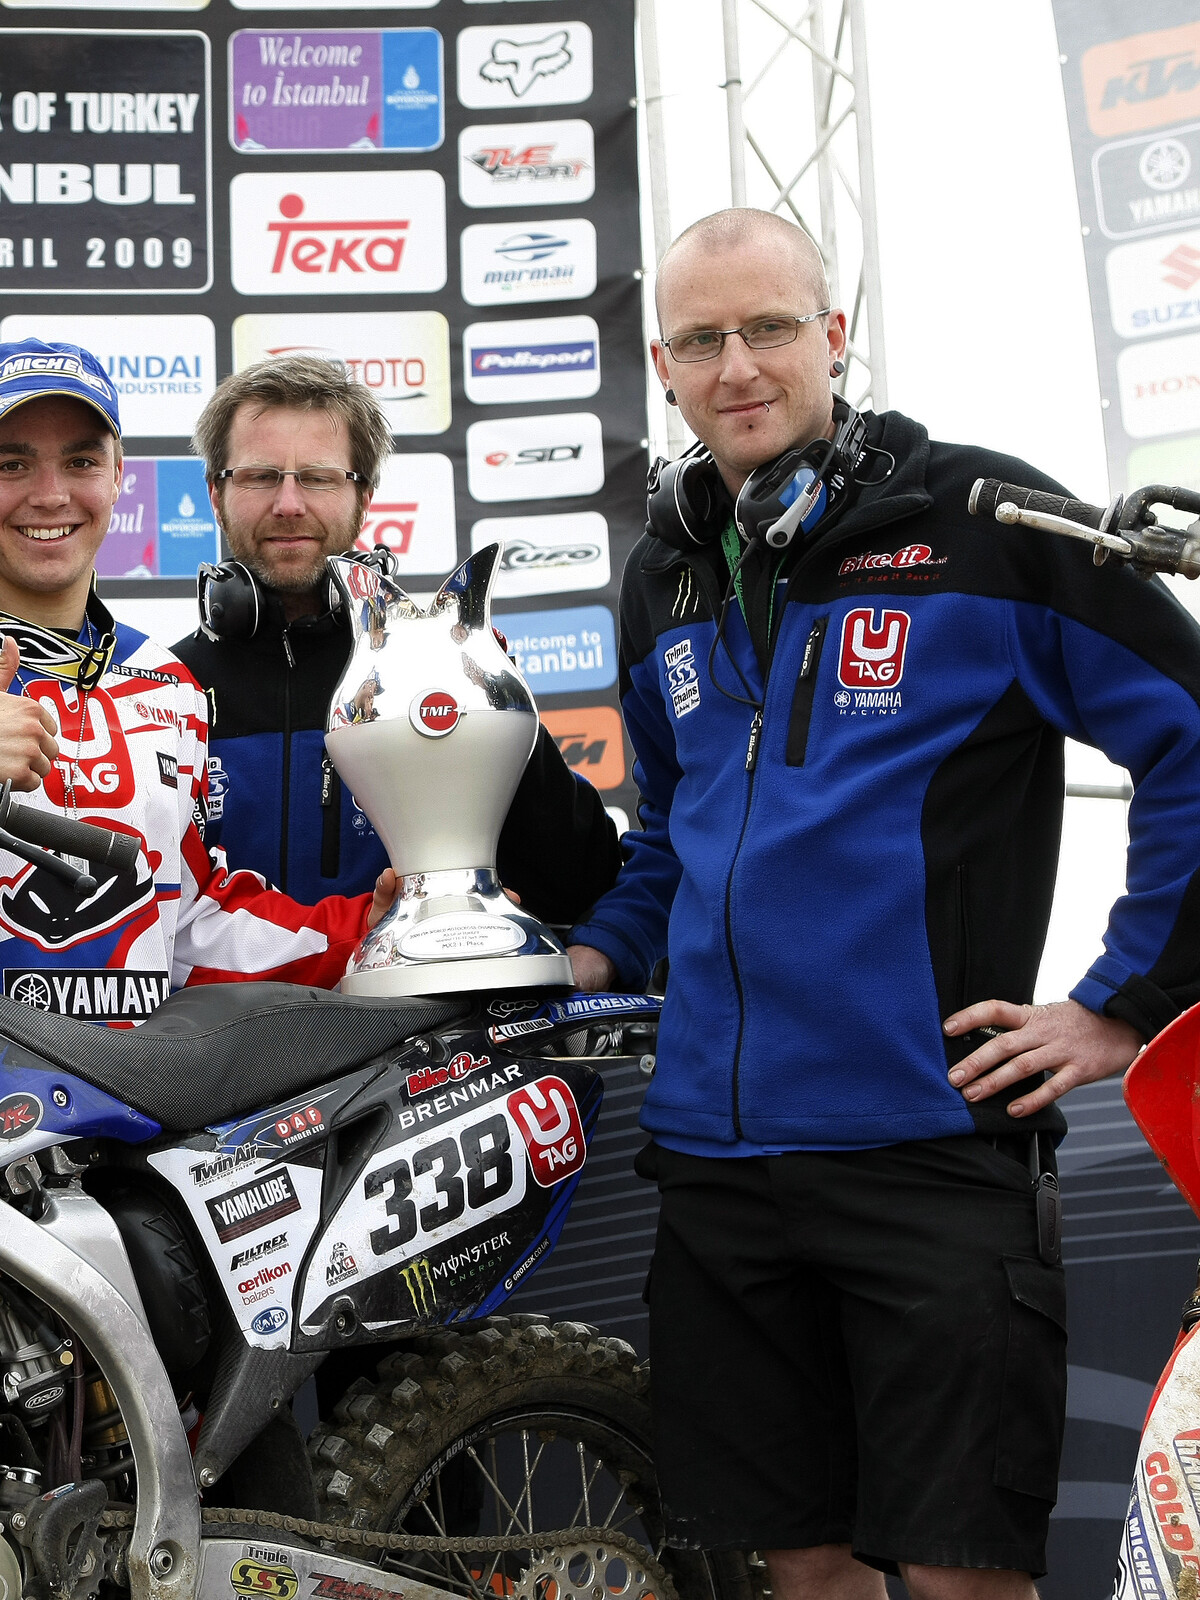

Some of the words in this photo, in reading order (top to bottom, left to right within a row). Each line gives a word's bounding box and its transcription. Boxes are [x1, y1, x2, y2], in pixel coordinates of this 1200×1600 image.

[259, 36, 363, 68] Welcome
[242, 82, 267, 108] to
[12, 90, 58, 134] OF
[65, 91, 200, 134] TURKEY
[493, 162, 583, 182] SPORT
[1128, 189, 1200, 224] YAMAH
[86, 236, 194, 268] 2009
[105, 354, 201, 379] UNDAI
[480, 347, 592, 371] Polisport
[112, 382, 203, 395] NDUSTRIES
[838, 551, 891, 576] Bike
[581, 630, 601, 646] to
[516, 645, 604, 674] tanbul
[665, 642, 689, 664] Triple
[111, 665, 179, 688] BRENMAR
[849, 661, 896, 682] TAG
[673, 685, 699, 708] Chains
[853, 691, 902, 708] YAMAHA
[420, 705, 453, 718] TMF
[839, 708, 898, 716] RACING
[52, 760, 120, 795] TAG
[567, 996, 649, 1014] MICHELIN
[407, 1066, 450, 1096] Bike
[400, 1064, 523, 1131] BRENMAR
[282, 1130, 312, 1146] TIMBER
[312, 1123, 326, 1136] LTD
[189, 1153, 233, 1185] Twin
[233, 1143, 258, 1168] Air
[538, 1136, 579, 1172] TAG
[363, 1112, 510, 1257] 338
[214, 1175, 292, 1226] YAMALUBE
[230, 1231, 288, 1271] FILTREX
[449, 1254, 504, 1287] ENERGY
[242, 1284, 276, 1306] balzers
[413, 1457, 446, 1497] EXCEL
[247, 1544, 289, 1565] Triple
